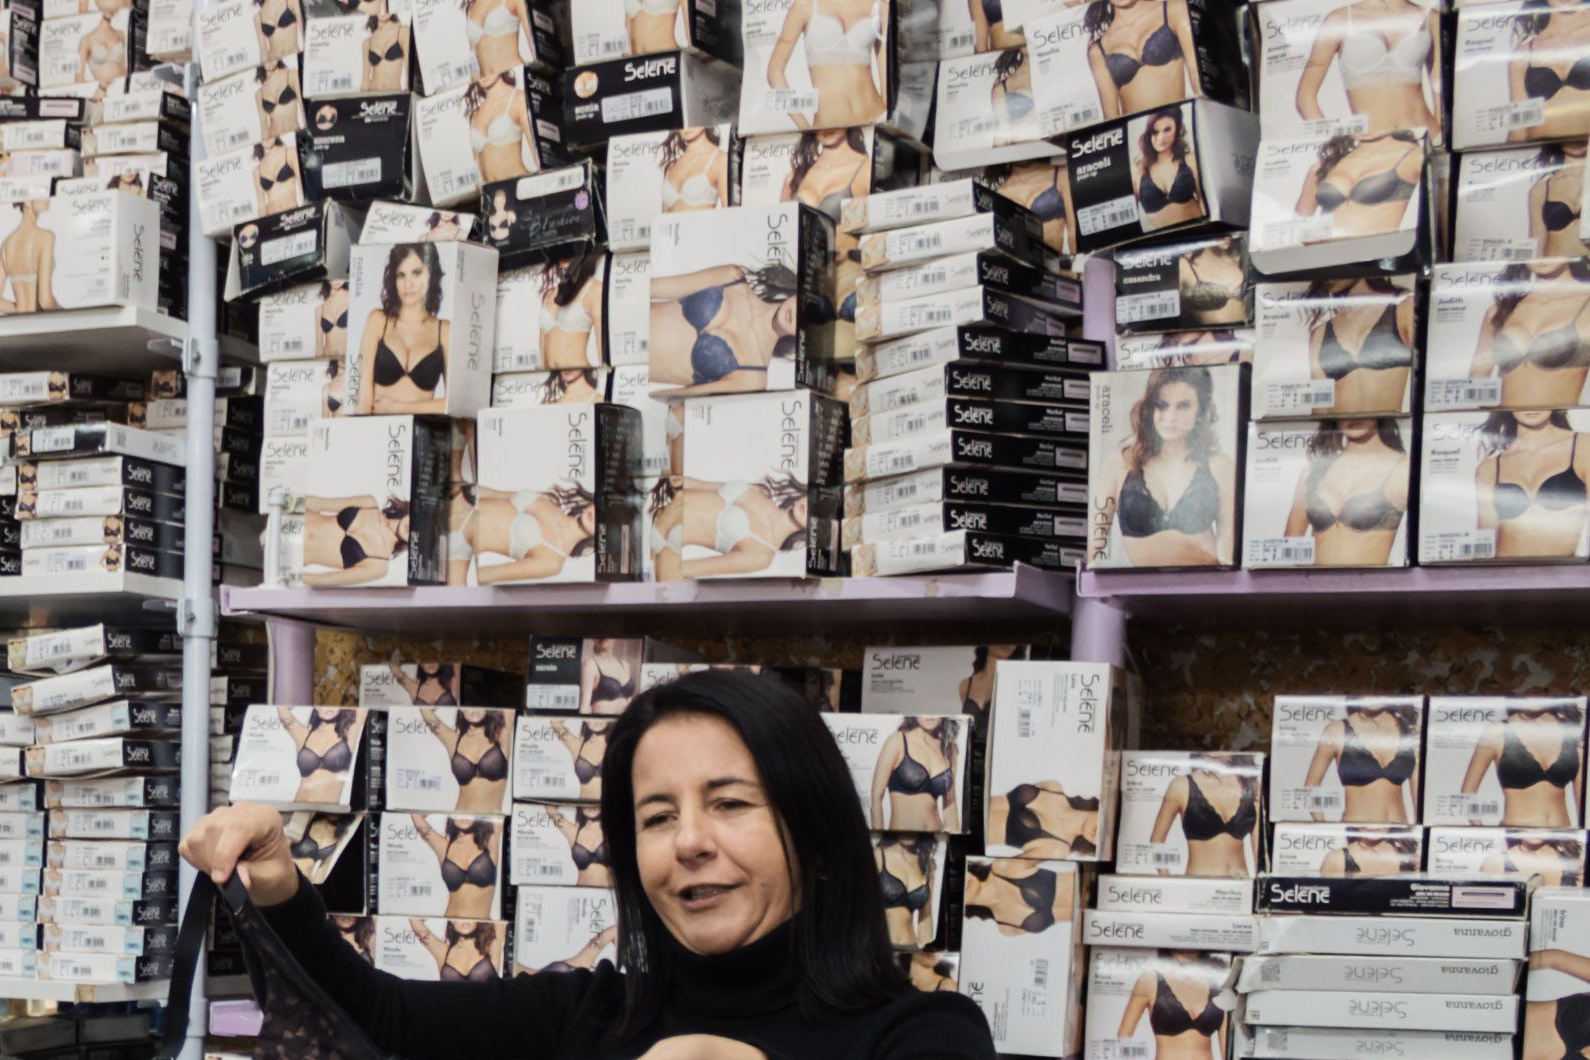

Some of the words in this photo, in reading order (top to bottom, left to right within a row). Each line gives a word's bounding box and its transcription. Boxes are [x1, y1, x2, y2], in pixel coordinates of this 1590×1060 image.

[1076, 157, 1111, 175] araceli
[766, 213, 788, 270] Selen
[615, 260, 650, 275] Selen
[619, 370, 648, 388] Sele
[831, 727, 878, 745] elene
[1453, 928, 1512, 940] giovanna
[1440, 966, 1499, 977] giovanna
[1445, 1001, 1503, 1012] giovanna
[1444, 1033, 1503, 1044] giovanna
